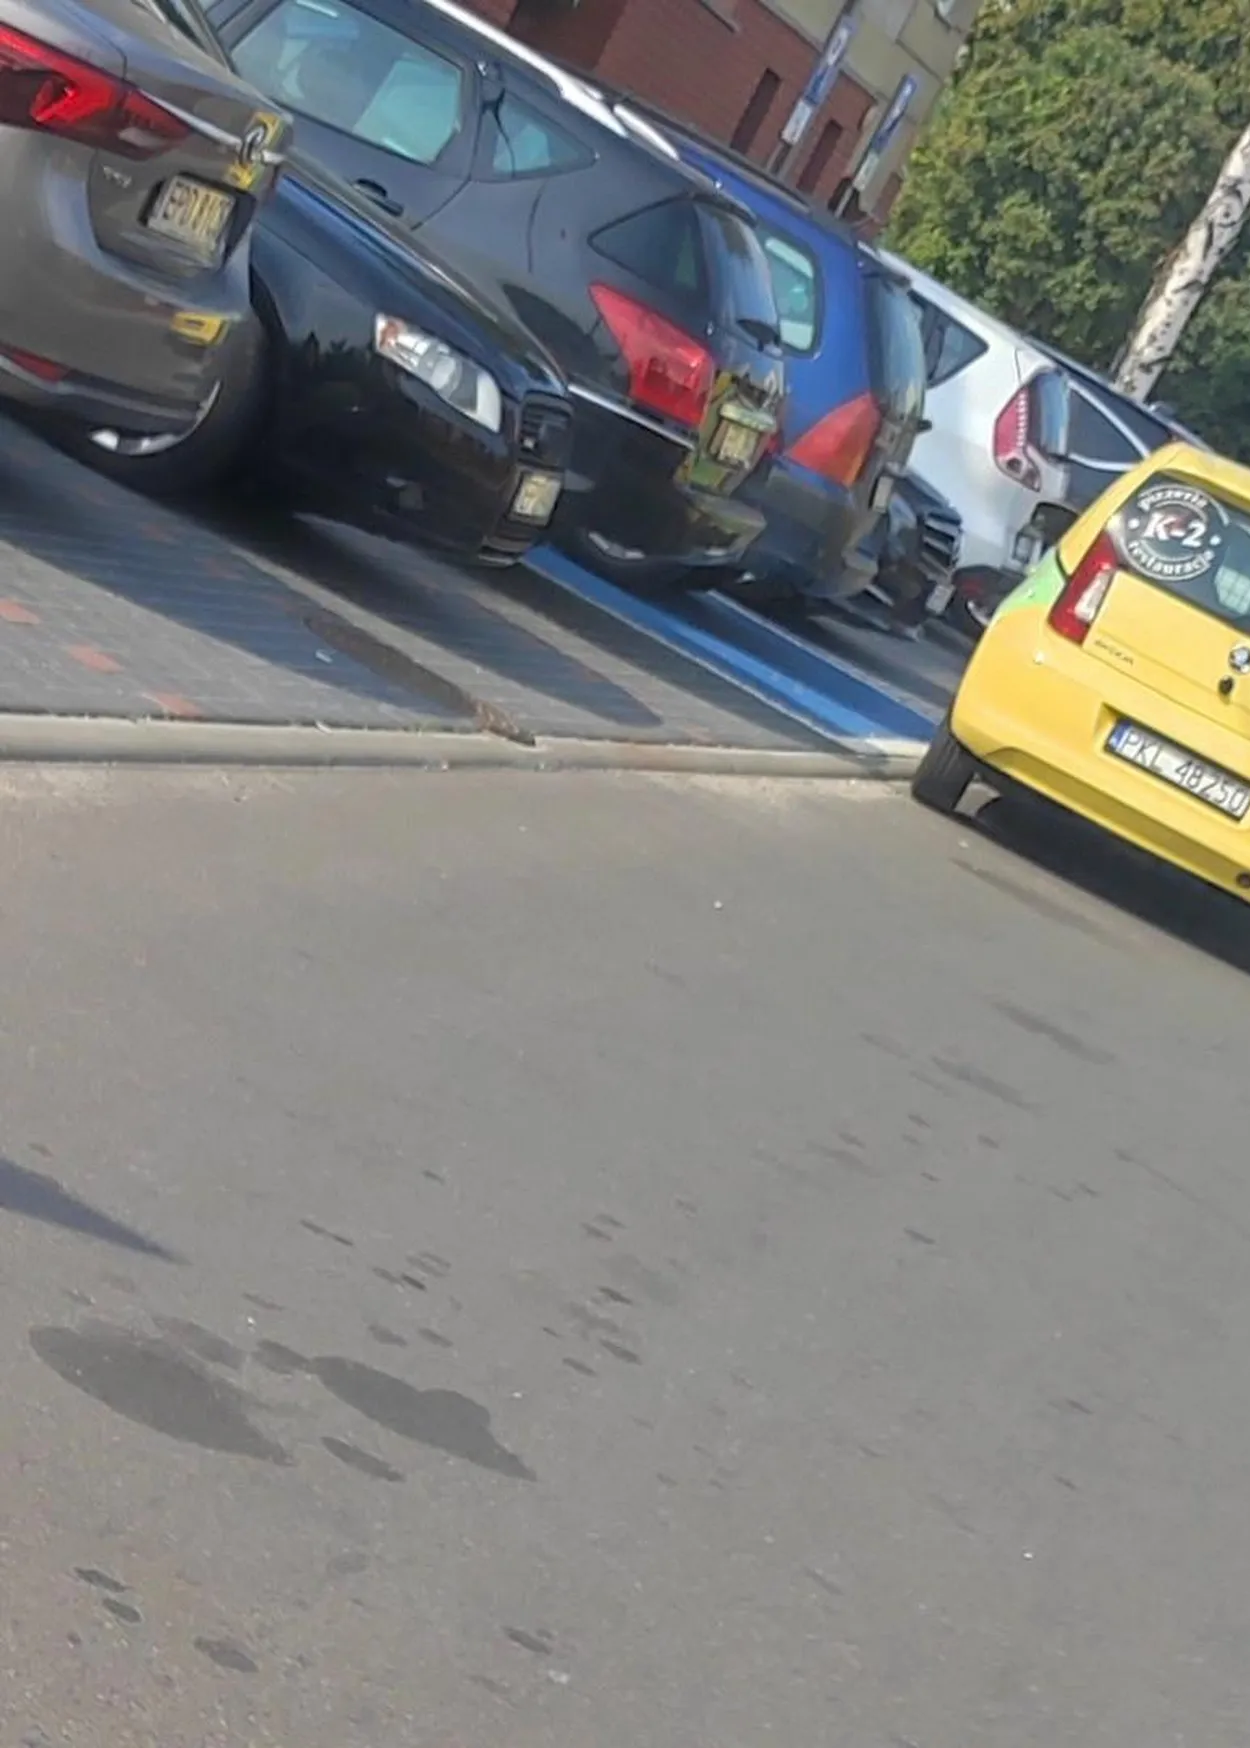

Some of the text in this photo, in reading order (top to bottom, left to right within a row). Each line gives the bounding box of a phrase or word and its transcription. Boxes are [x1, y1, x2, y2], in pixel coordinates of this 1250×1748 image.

[1137, 488, 1208, 511] pizzeria
[1120, 729, 1249, 813] PKL 48250
